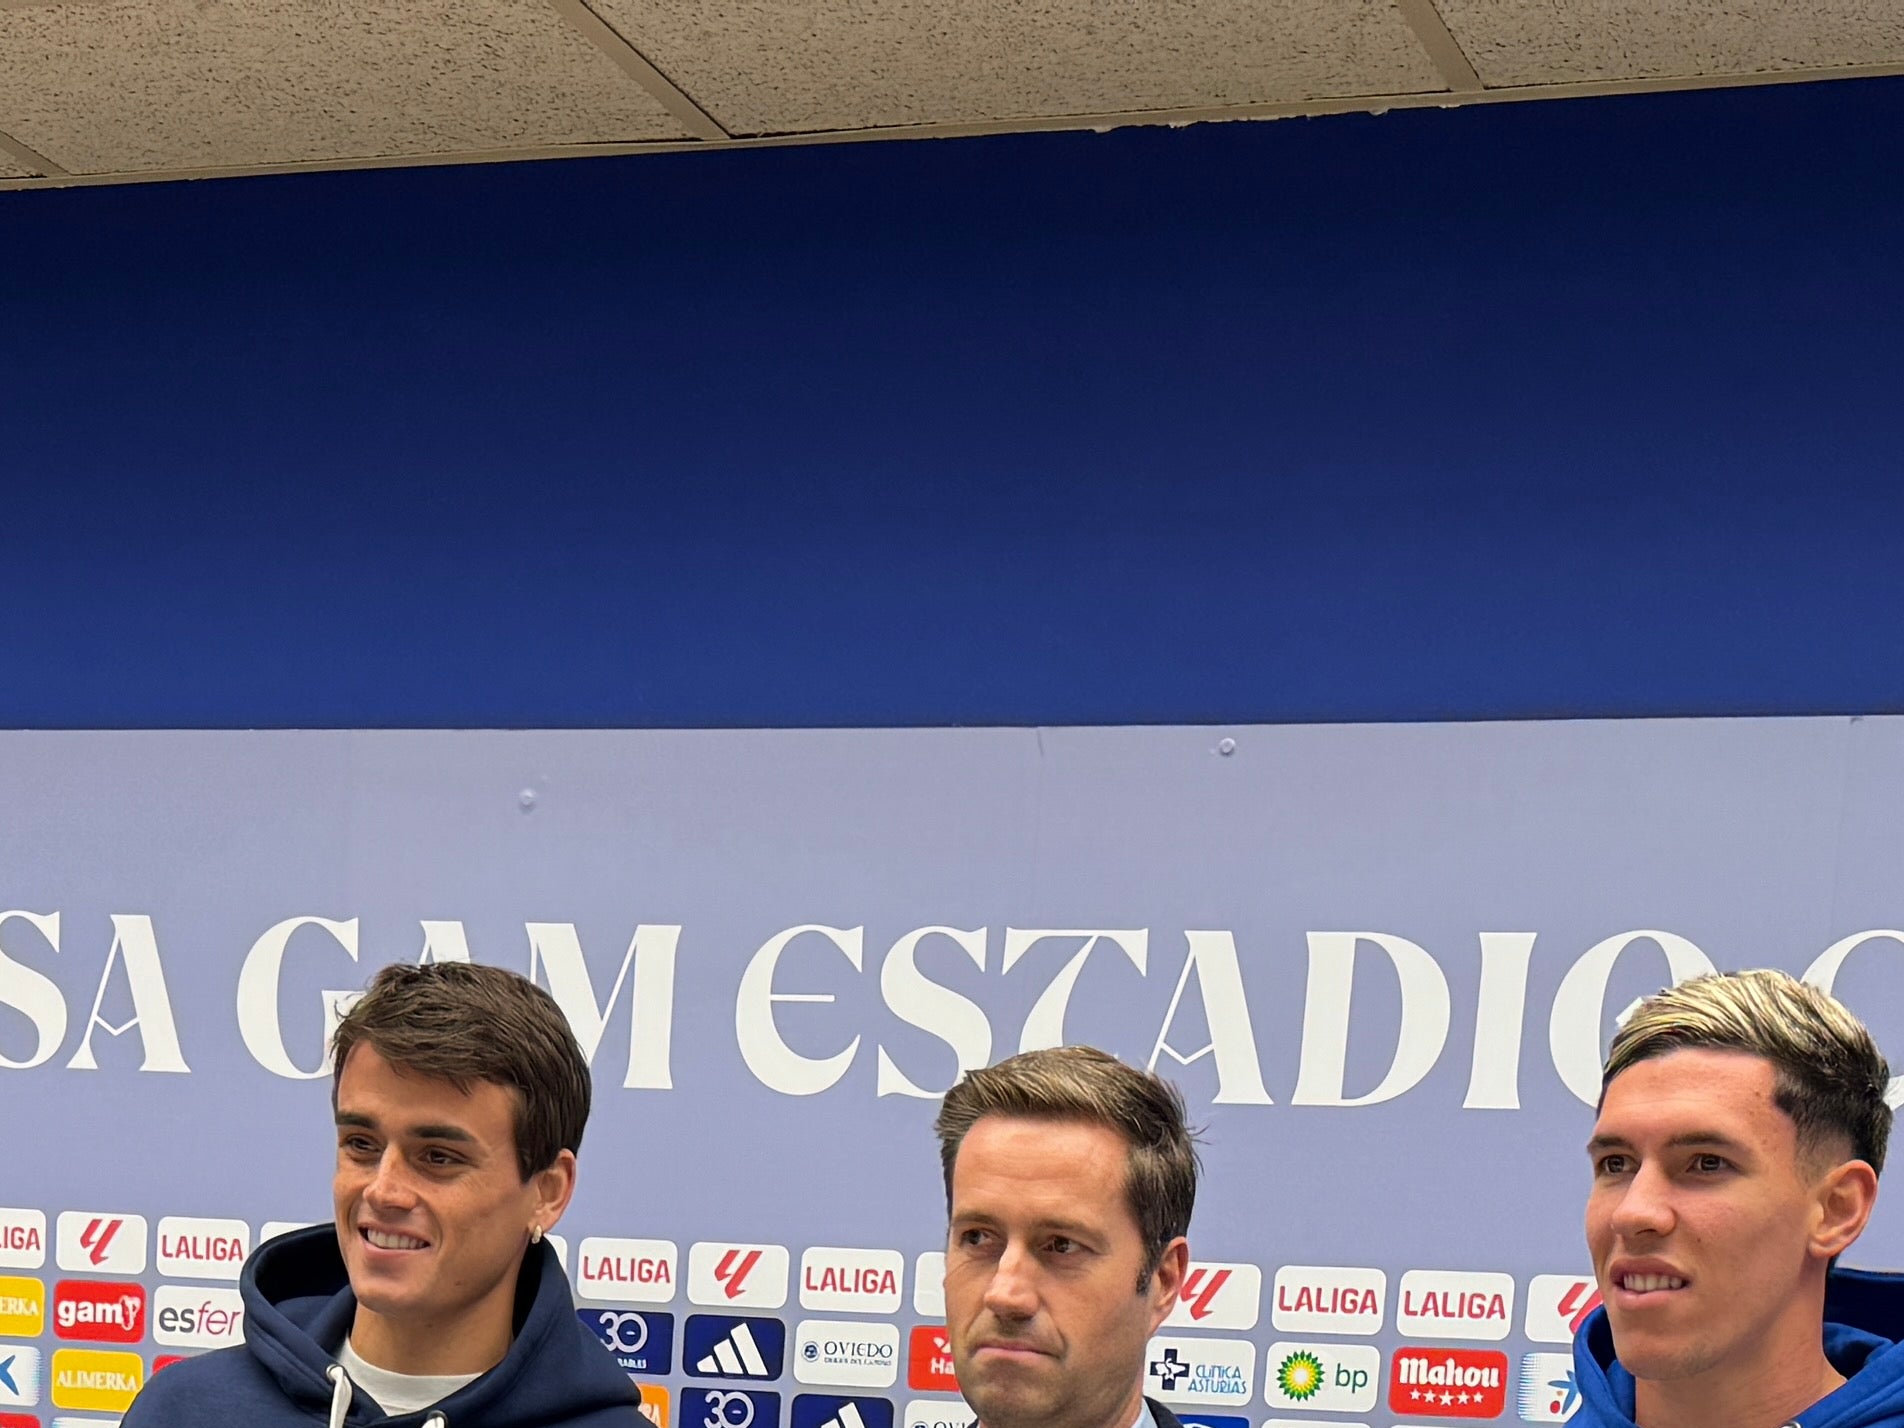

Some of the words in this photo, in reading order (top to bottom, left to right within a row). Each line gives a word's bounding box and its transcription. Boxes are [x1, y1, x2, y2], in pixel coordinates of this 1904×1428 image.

[735, 924, 1728, 1110] ESTADIO
[162, 1235, 243, 1261] LALIGA
[584, 1256, 670, 1283] LALIGA
[806, 1267, 896, 1294] LALIGA
[1279, 1286, 1377, 1314] LALIGA
[1404, 1291, 1505, 1319] LALIGA
[159, 1301, 240, 1335] esfer
[824, 1341, 892, 1358] OVIEDO
[1336, 1363, 1367, 1393] bp
[1400, 1358, 1498, 1387] Mahou
